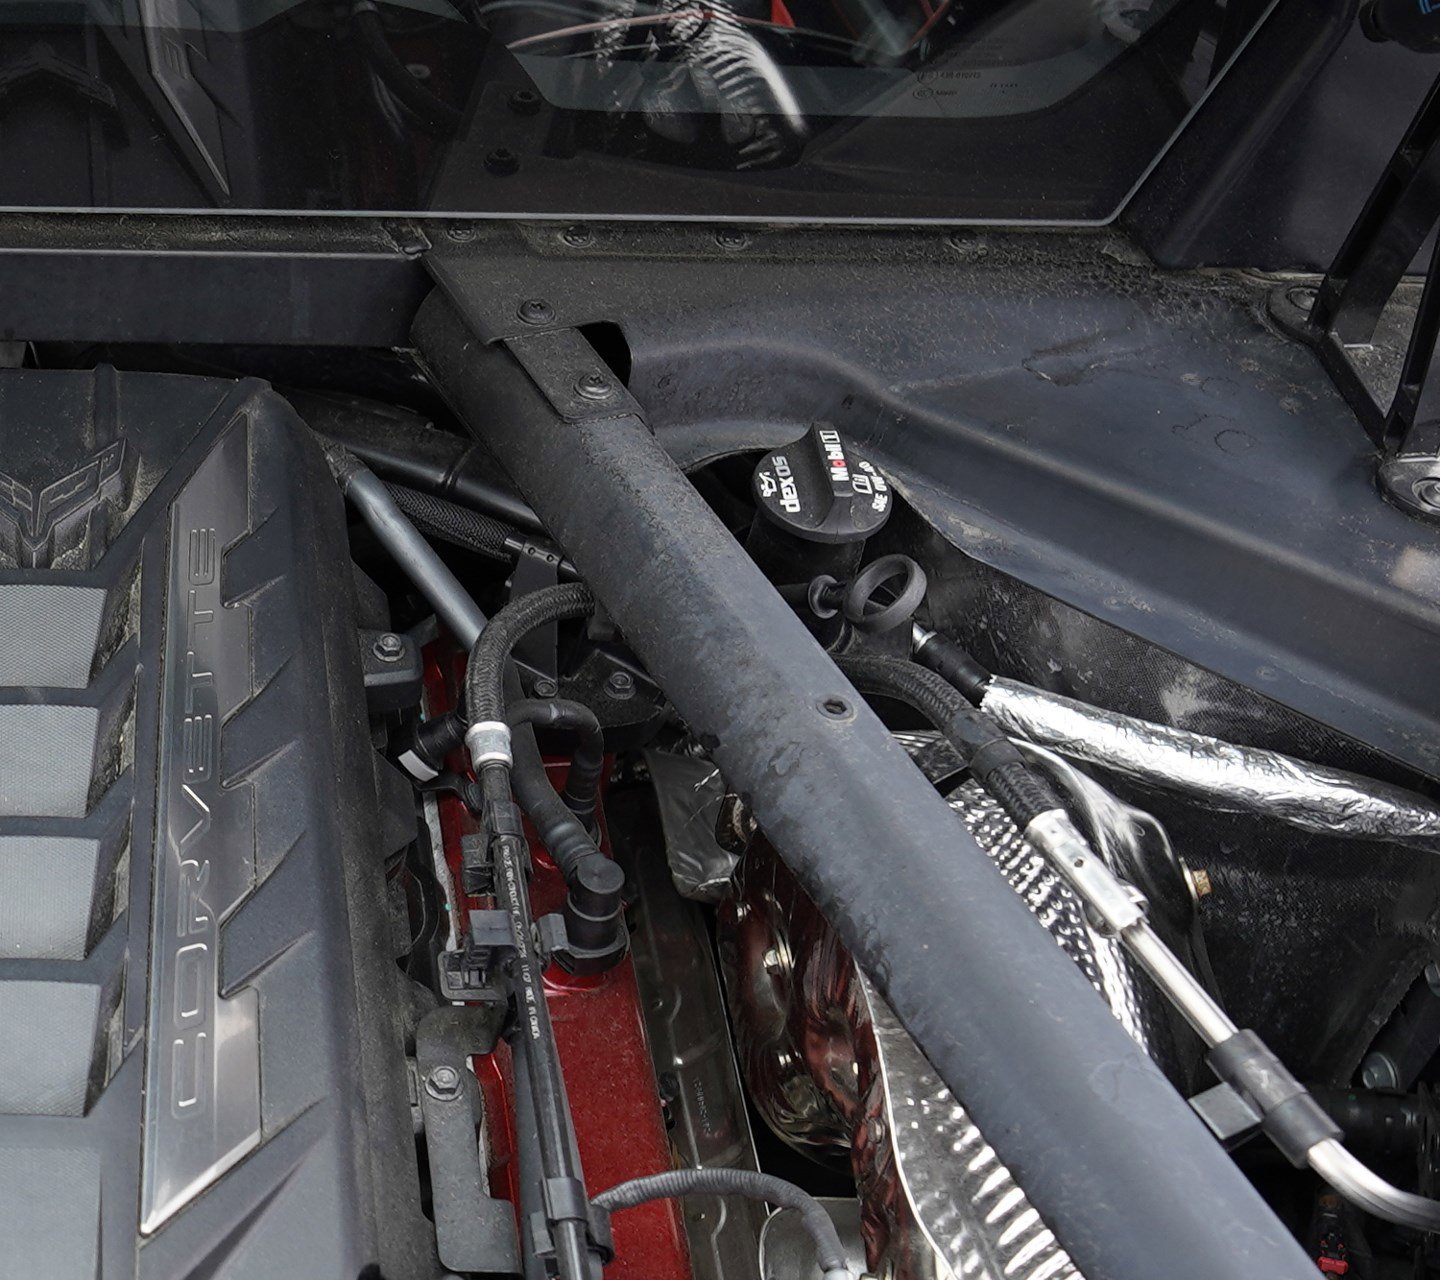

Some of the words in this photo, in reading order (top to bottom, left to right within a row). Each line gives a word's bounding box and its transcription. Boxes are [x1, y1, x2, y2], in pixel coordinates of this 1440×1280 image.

[772, 456, 801, 513] dexos
[871, 492, 888, 512] SAE
[171, 527, 216, 1119] CORVETTE
